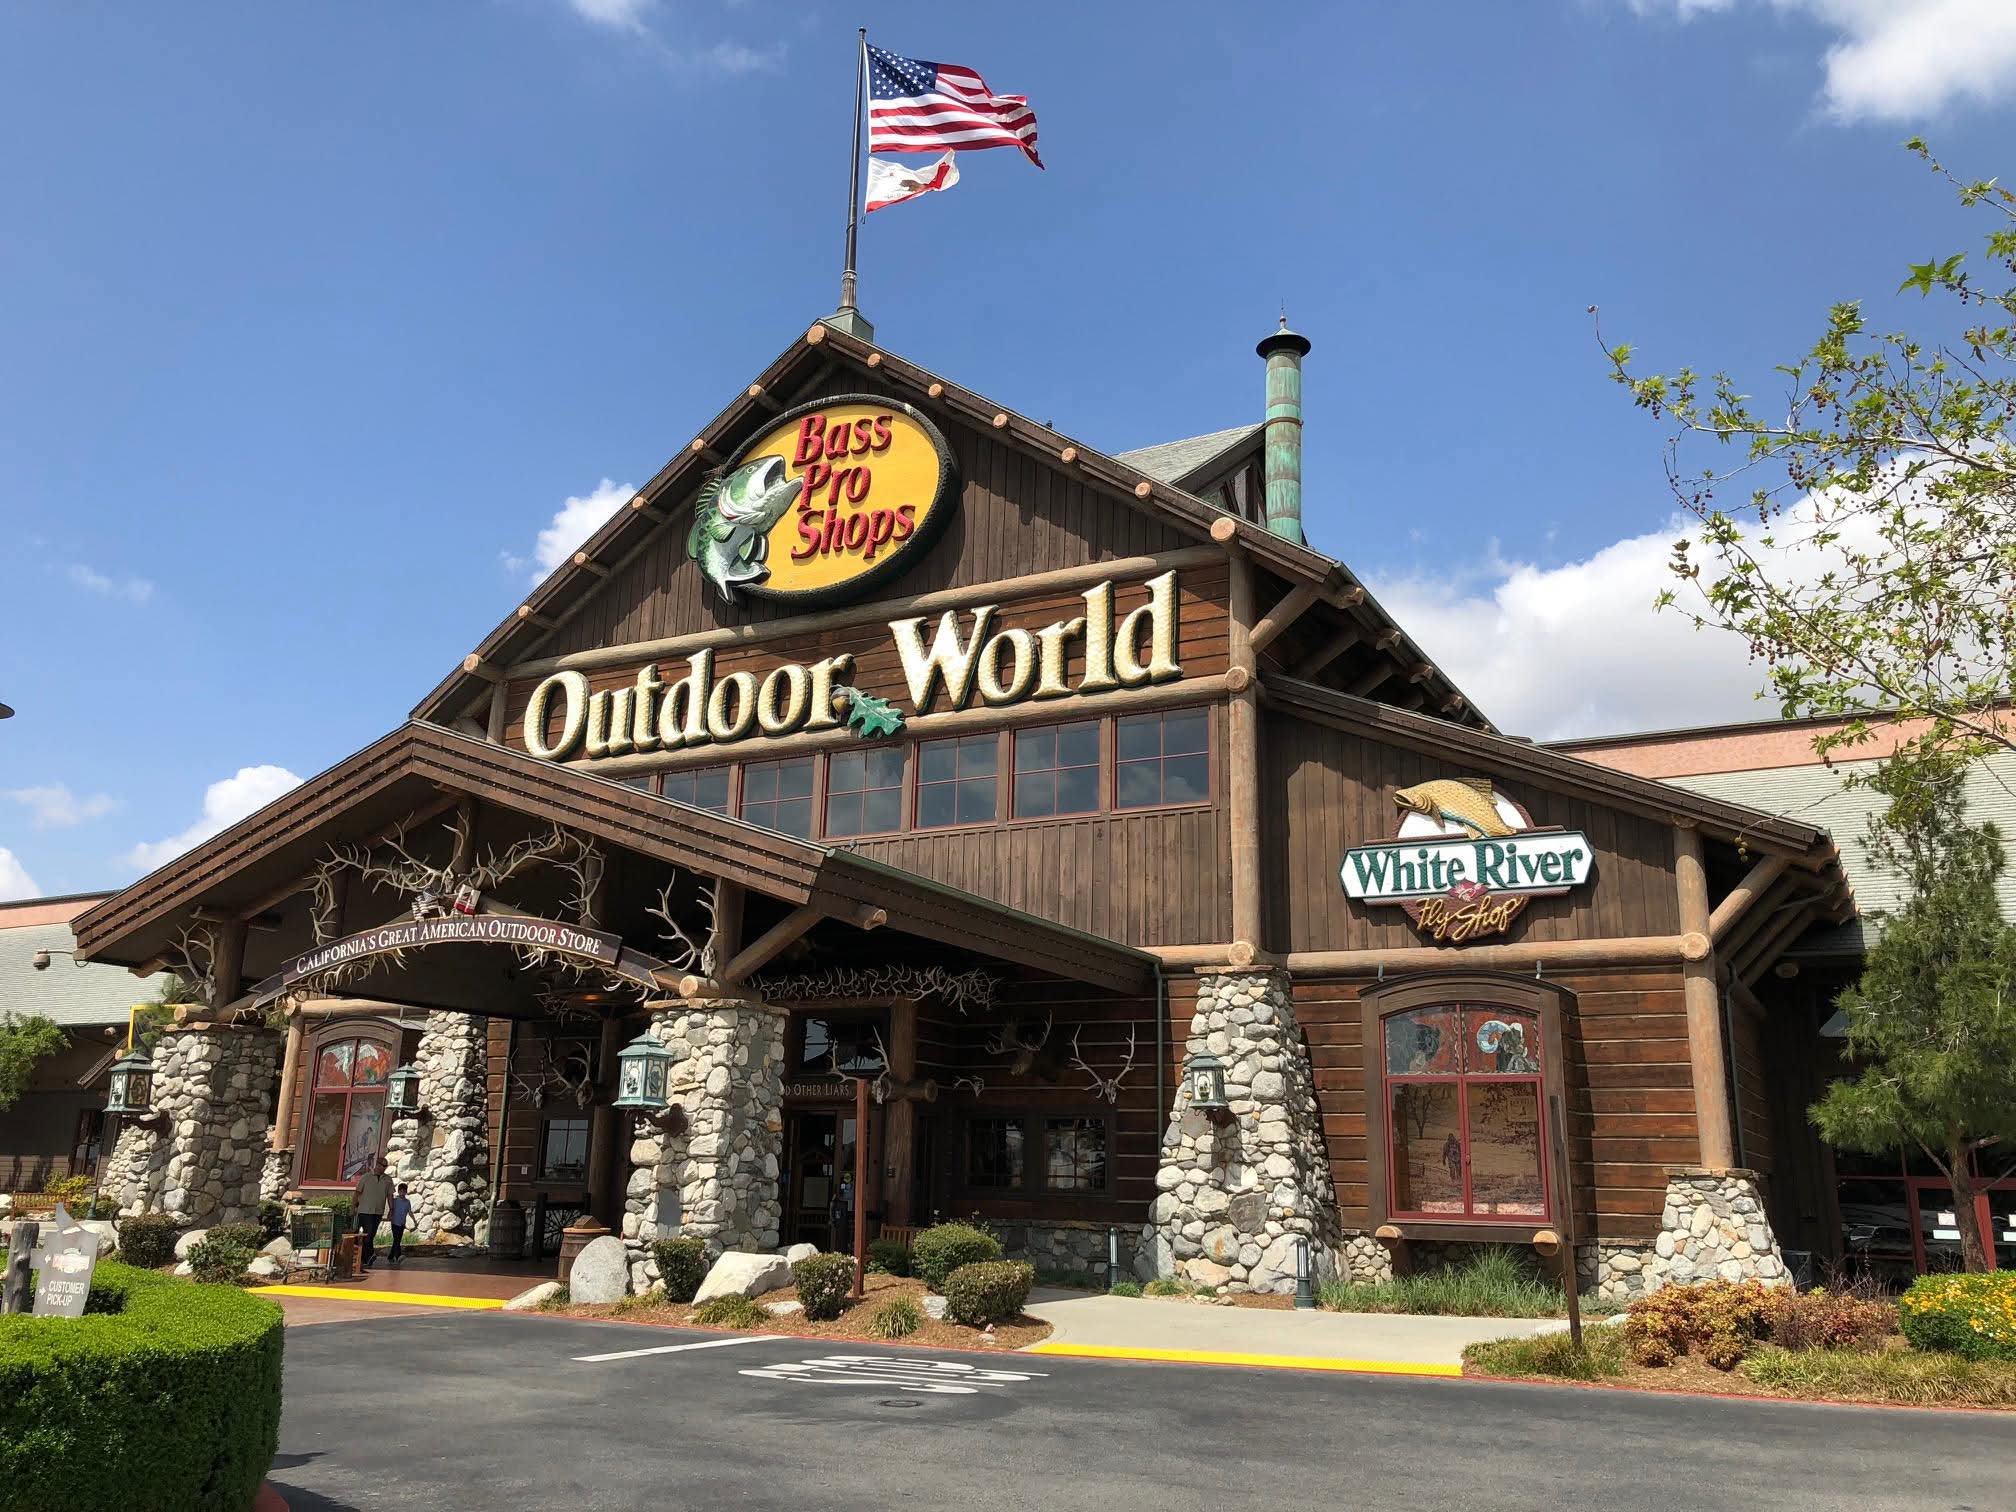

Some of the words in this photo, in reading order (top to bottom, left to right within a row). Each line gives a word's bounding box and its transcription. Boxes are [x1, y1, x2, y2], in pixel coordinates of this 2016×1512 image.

[792, 414, 893, 467] Bass
[797, 463, 872, 512] Pro
[791, 504, 916, 559] Shops
[523, 647, 856, 762] Outdoor
[888, 570, 1184, 715] World
[1350, 848, 1466, 894] White
[1472, 842, 1583, 889] River
[1416, 897, 1451, 940] Fly
[1449, 896, 1524, 942] Shop
[296, 935, 377, 974] CALIFORNIA'S
[378, 927, 418, 948] GREAT
[419, 922, 487, 941] AMERICAN
[489, 919, 557, 944] OUTDOOR
[557, 928, 602, 955] STORE
[794, 1083, 822, 1097] OTHER
[825, 1083, 850, 1097] LIARS
[46, 1293, 73, 1306] PICK-UP
[49, 1280, 85, 1295] CUSTOMER
[738, 1356, 1049, 1394] STOP
